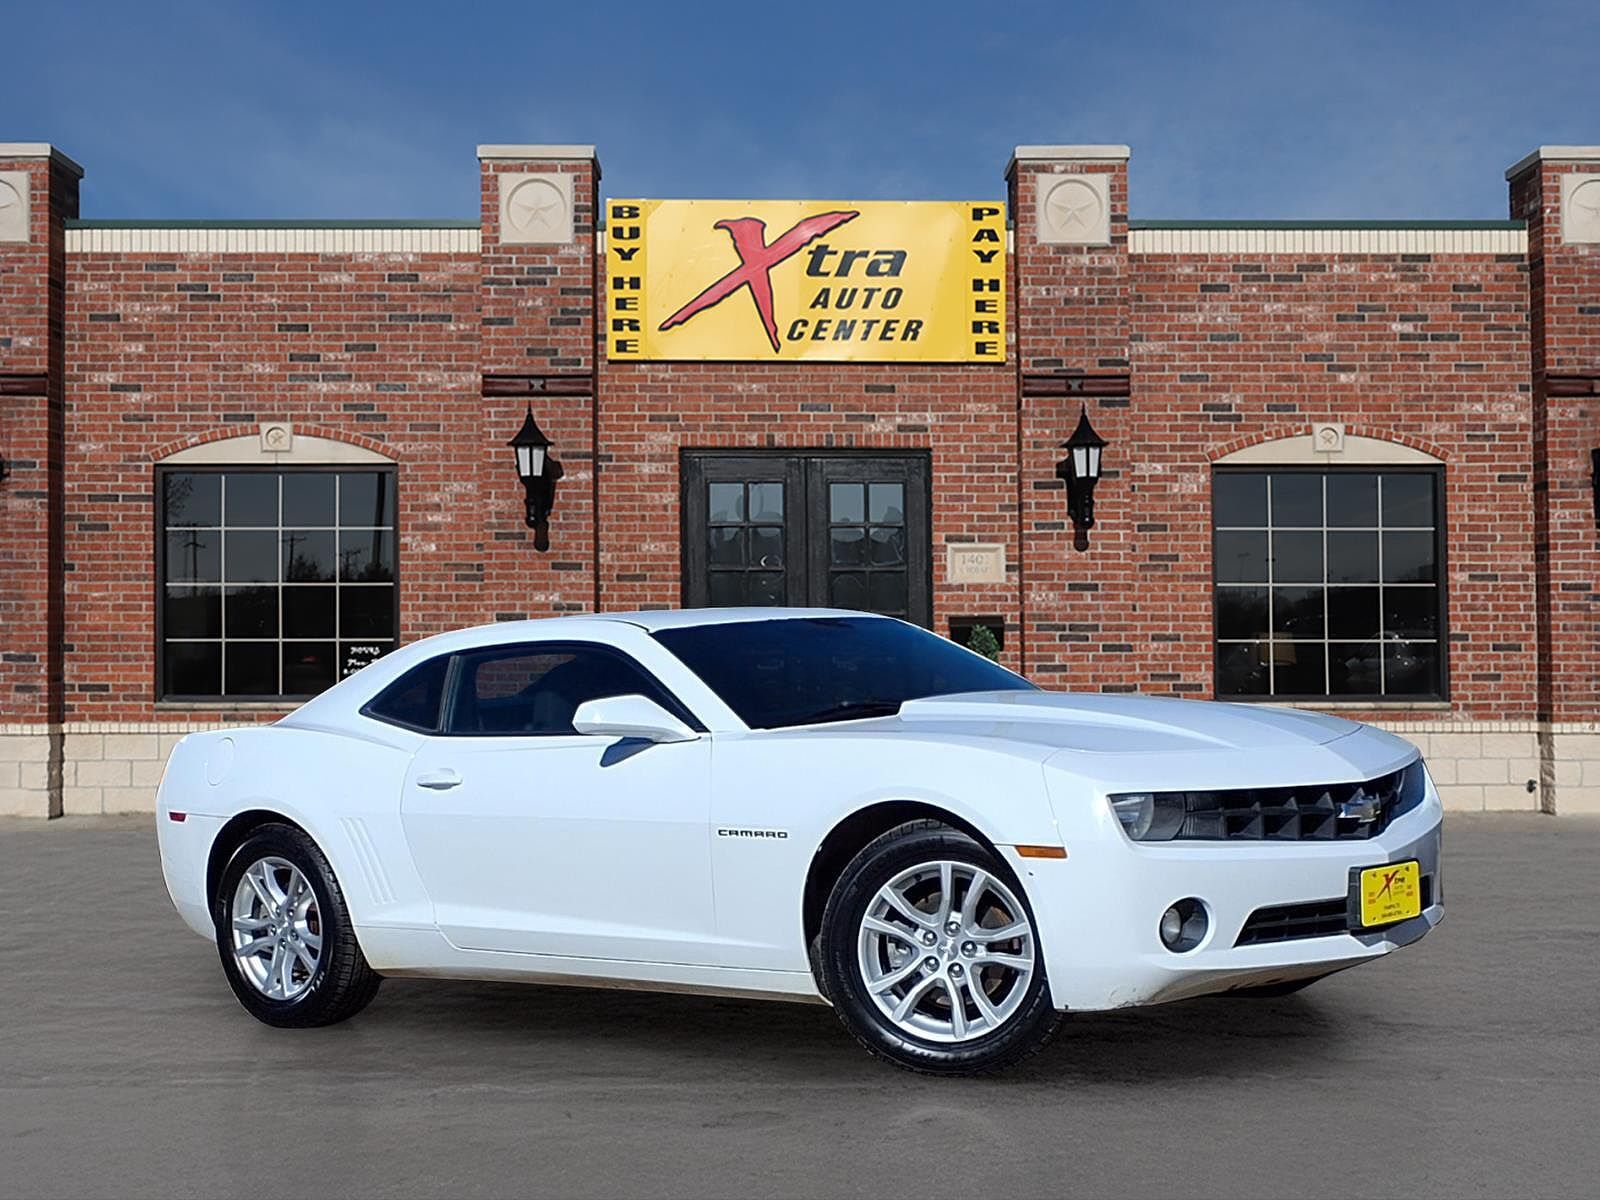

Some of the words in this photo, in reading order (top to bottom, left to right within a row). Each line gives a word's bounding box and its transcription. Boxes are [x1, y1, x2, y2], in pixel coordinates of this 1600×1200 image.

[612, 205, 640, 261] BUY
[972, 207, 1000, 264] PAY
[658, 210, 907, 354] Xtra
[809, 287, 903, 310] AUTO
[612, 276, 641, 353] HERE
[786, 318, 923, 341] CENTER
[972, 278, 1000, 355] HERE
[717, 829, 788, 839] CAMARO
